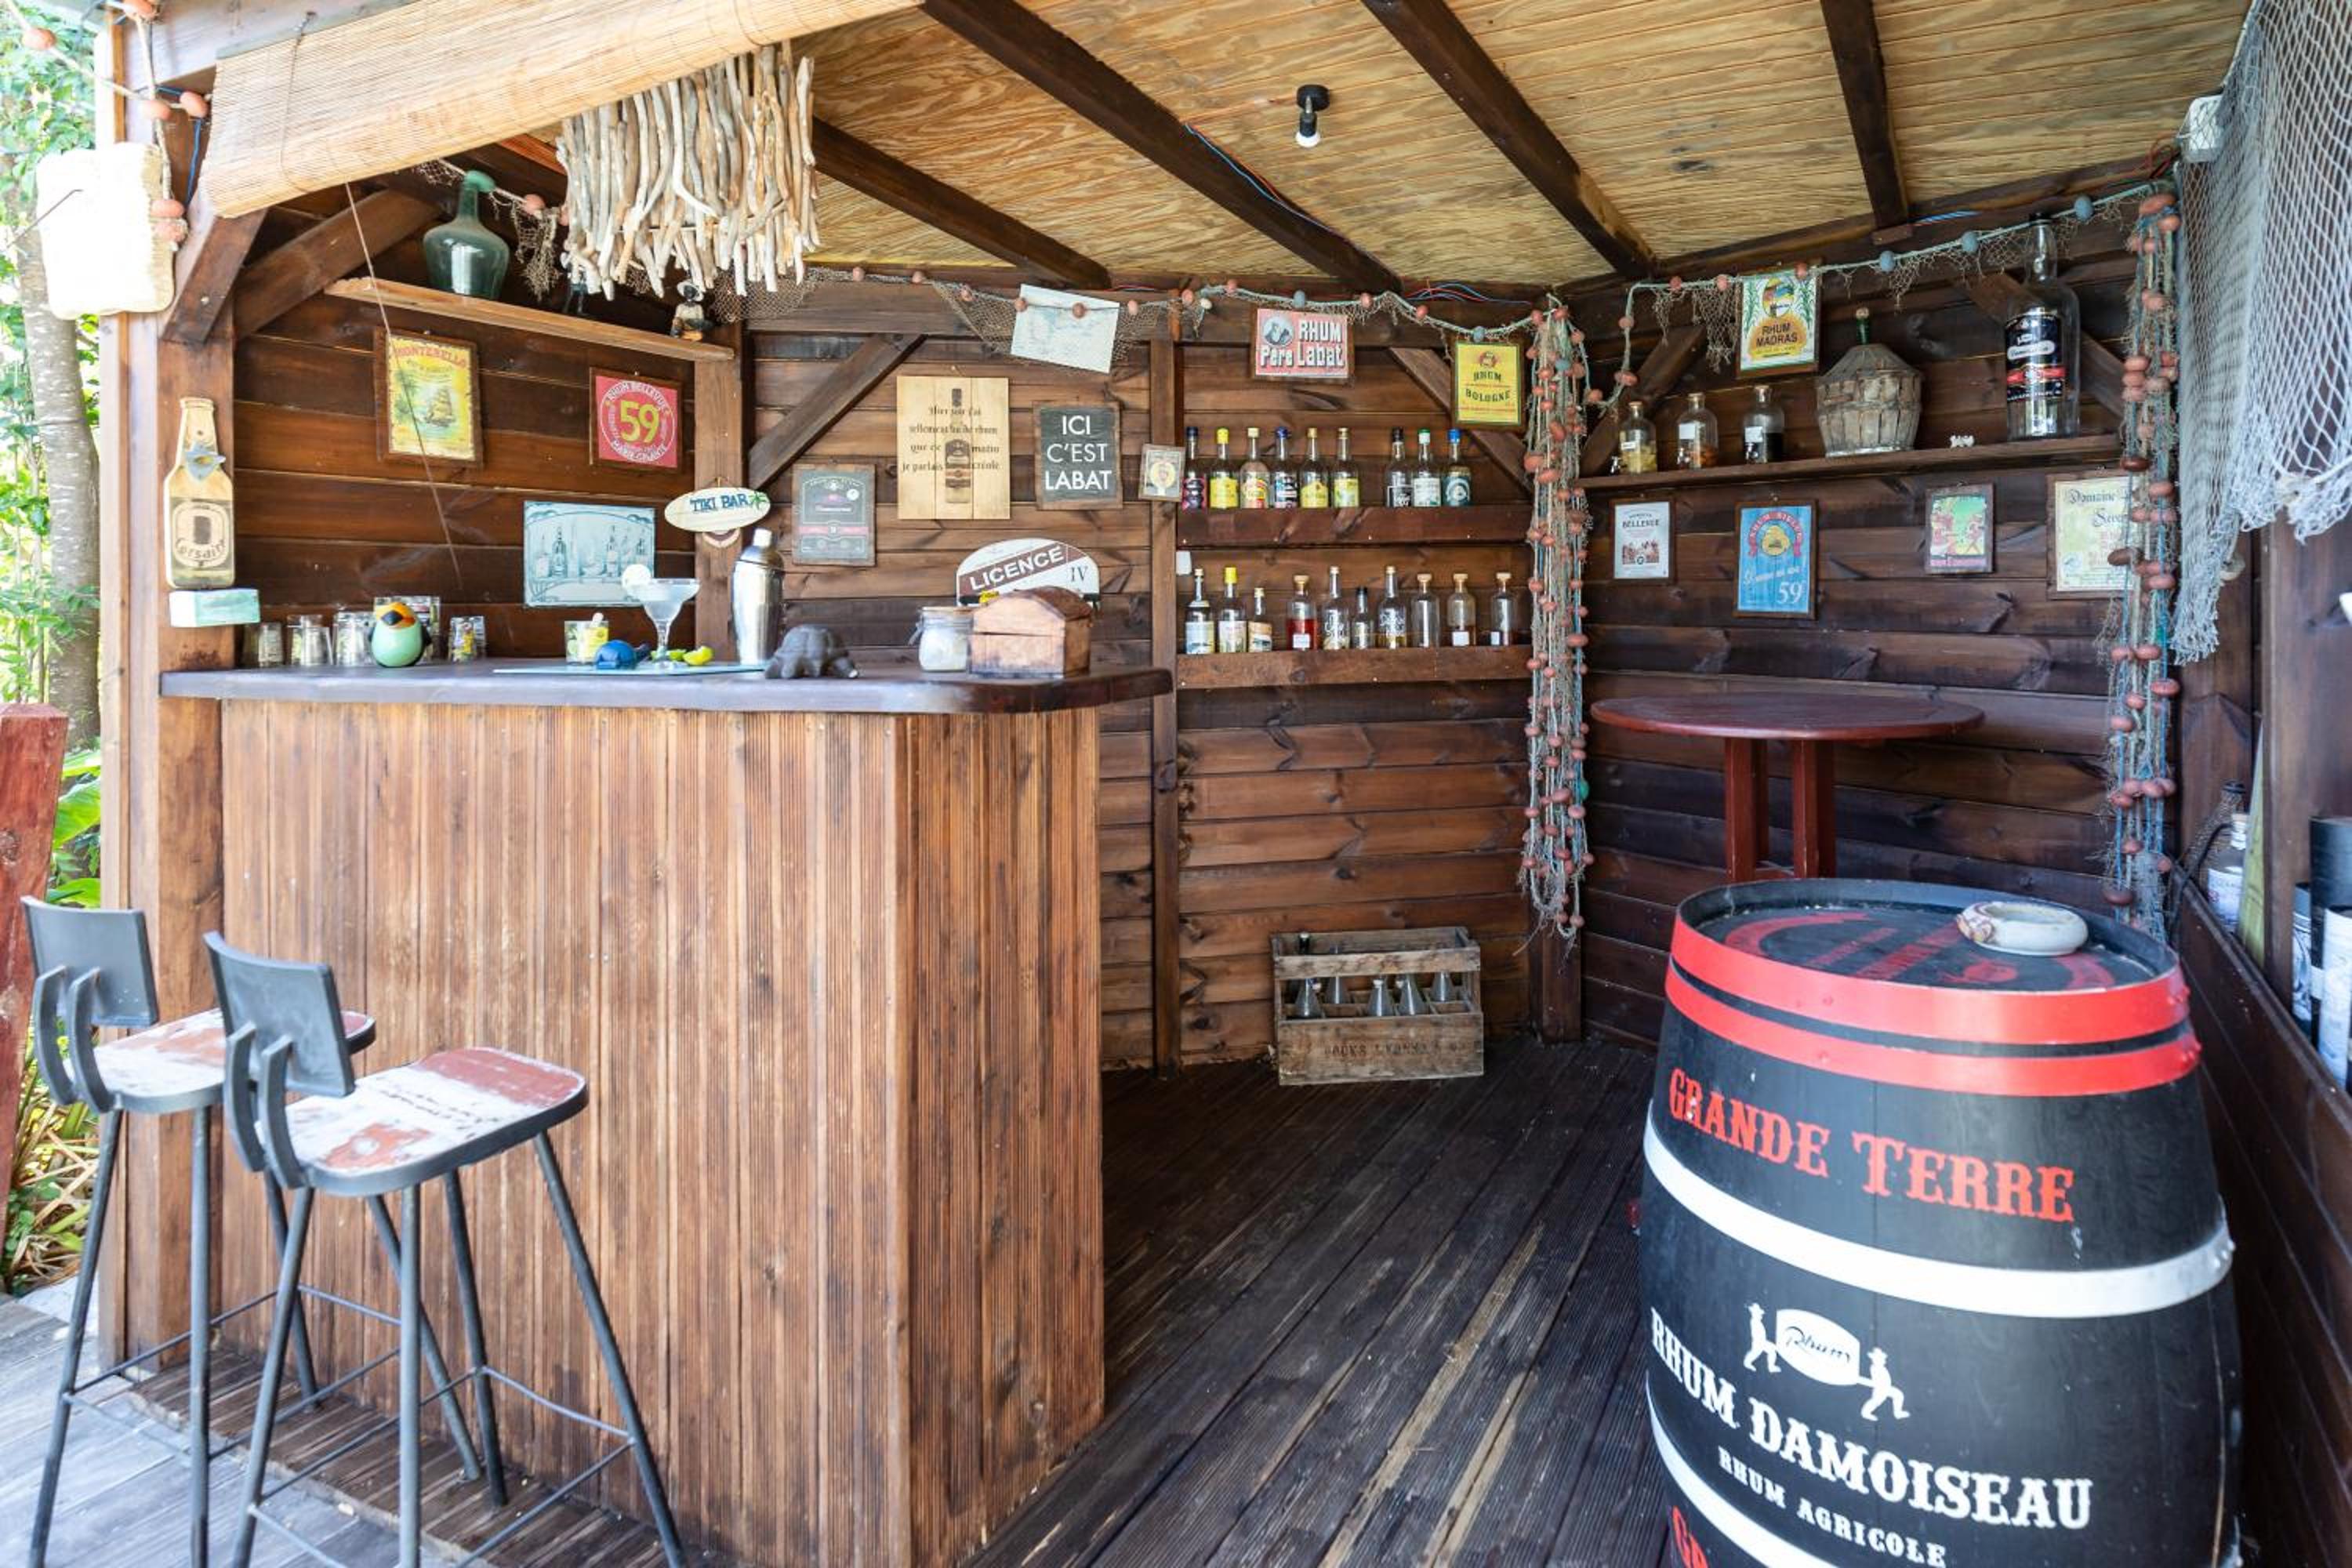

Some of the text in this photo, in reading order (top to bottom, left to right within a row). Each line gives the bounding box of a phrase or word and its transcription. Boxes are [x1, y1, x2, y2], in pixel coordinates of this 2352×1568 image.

[1299, 319, 1342, 342] RHUM
[1761, 322, 1791, 336] RHUM
[1756, 332, 1798, 347] MADRAS
[1298, 341, 1345, 368] Labat
[1473, 370, 1502, 383] RHUM
[1465, 387, 1511, 402] BOLOGNE
[620, 400, 659, 444] 59
[1062, 415, 1091, 435] ICI
[1046, 442, 1109, 463] C'EST
[1044, 470, 1113, 490] LABAT
[689, 493, 750, 513] TIKI BAR
[1622, 518, 1661, 528] BELLEVUE
[970, 545, 1065, 590] LICENCE
[1070, 565, 1089, 583] IV
[1669, 1068, 1831, 1178] GRANDE
[1852, 1131, 2075, 1222] TERRE
[1650, 1305, 2094, 1530] RHUM DAMOISEAU
[1718, 1446, 1947, 1567] RHUM AGRICOLE
